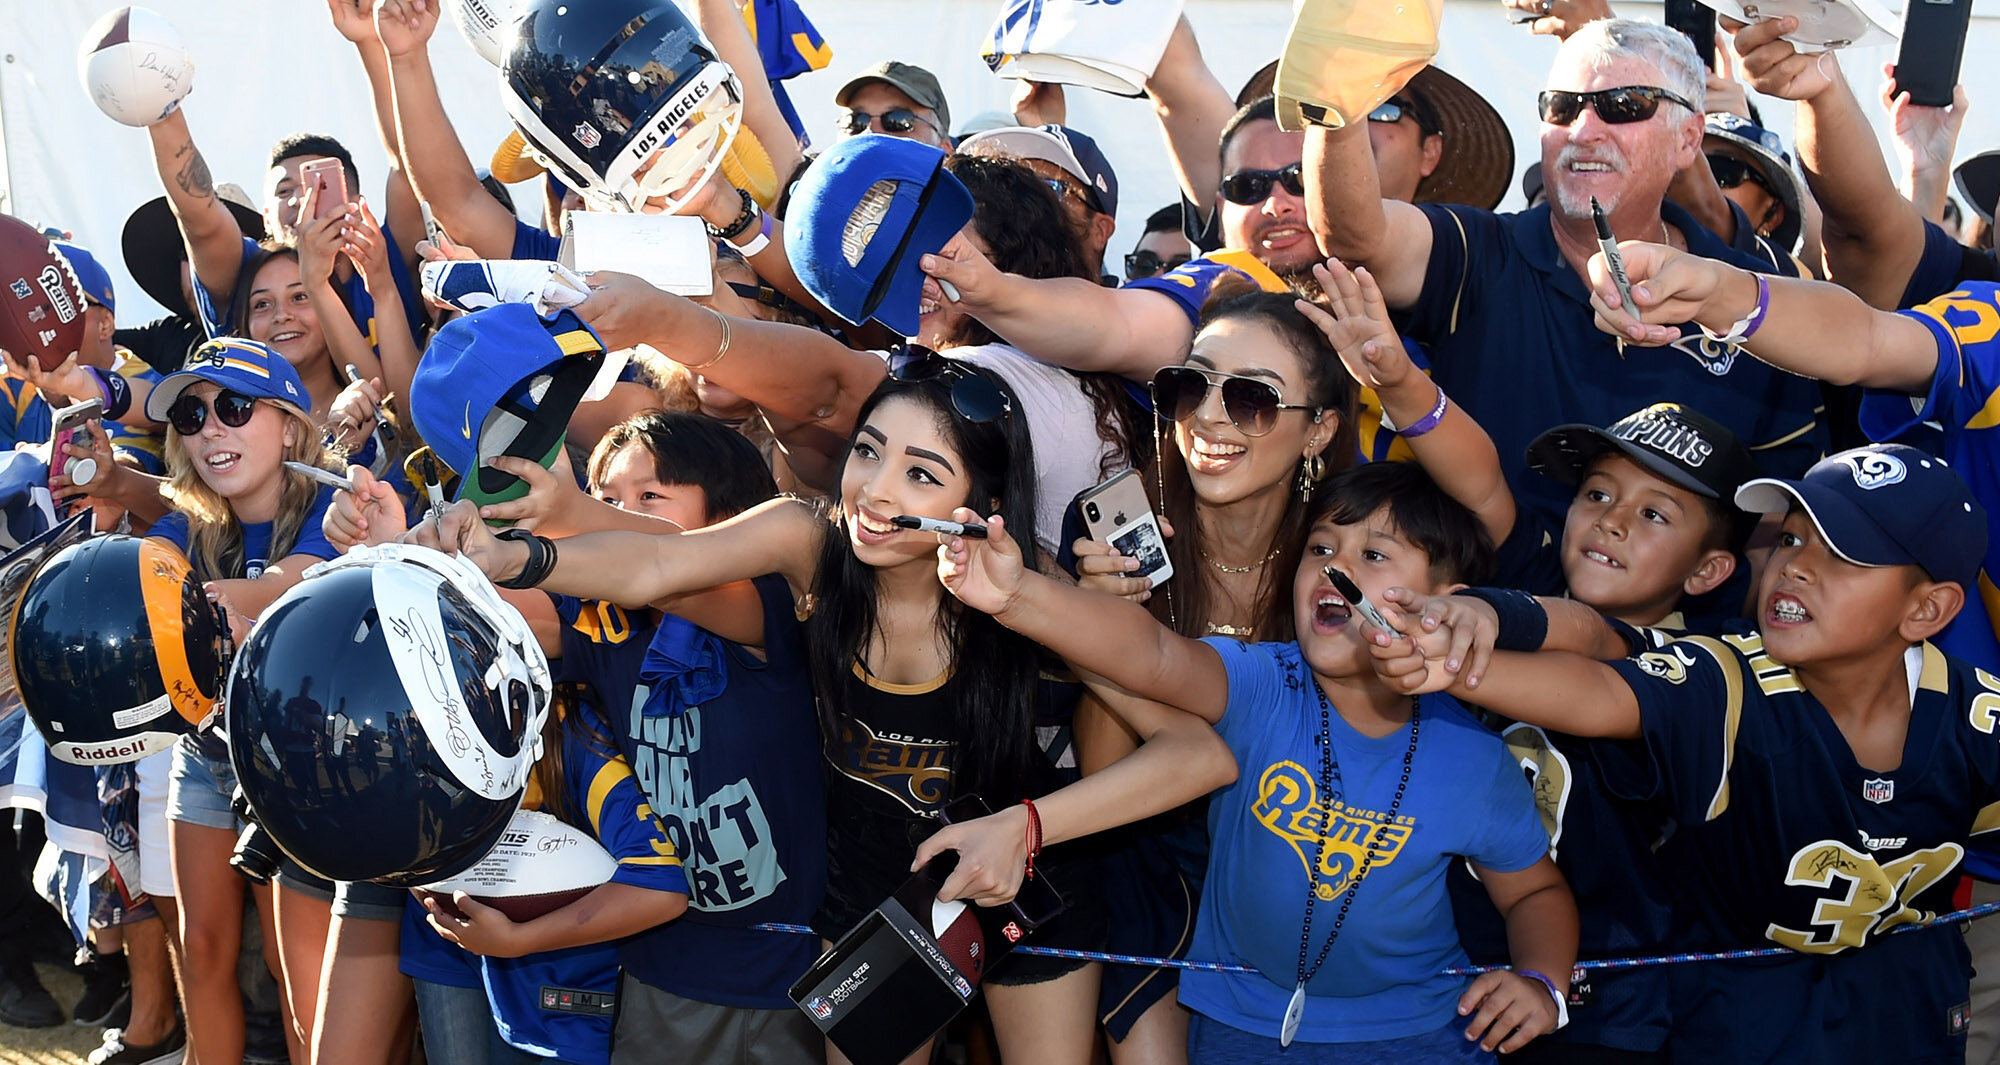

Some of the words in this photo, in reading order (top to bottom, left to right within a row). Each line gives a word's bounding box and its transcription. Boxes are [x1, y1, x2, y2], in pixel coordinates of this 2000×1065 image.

[467, 0, 498, 29] ams
[632, 132, 656, 160] LOS
[657, 80, 710, 136] ANGELES
[38, 266, 75, 323] Rams
[72, 740, 145, 760] Riddell
[877, 730, 914, 742] LOS
[1251, 760, 1413, 867] Rams
[1868, 789, 1889, 800] NFL
[660, 794, 760, 869] ON'T
[687, 859, 756, 908] RE
[828, 976, 854, 1000] YOUTH
[852, 962, 870, 979] SIZE
[833, 975, 869, 1006] FOOTBALL
